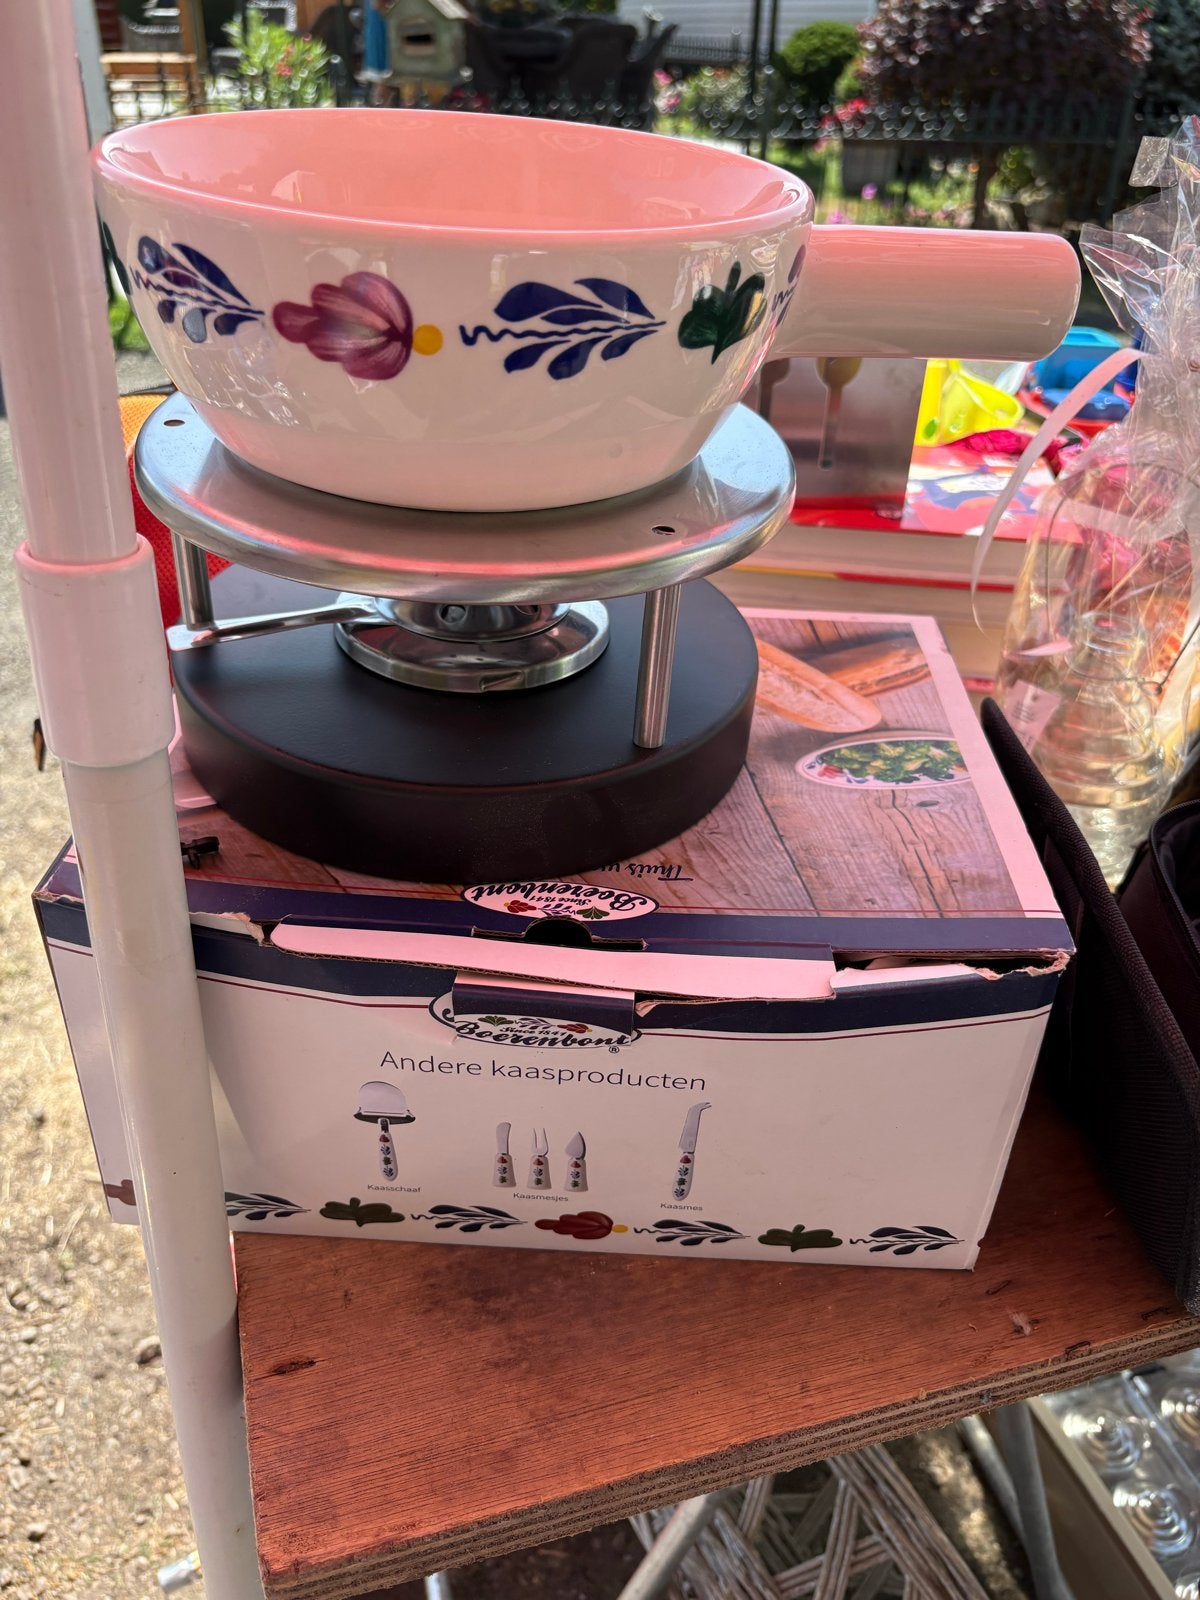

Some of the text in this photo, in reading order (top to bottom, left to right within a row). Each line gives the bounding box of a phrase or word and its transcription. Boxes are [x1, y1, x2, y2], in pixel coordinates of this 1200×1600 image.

[625, 863, 694, 881] Thuis
[471, 882, 648, 912] Boerenbont
[528, 895, 592, 906] Since 1841
[441, 1008, 630, 1047] Boerenbont
[500, 1026, 568, 1037] Since 1841
[380, 1051, 706, 1091] Andere kaasproducten
[367, 1184, 422, 1193] Kaasschaaf
[513, 1192, 569, 1202] Kaasmesjes
[660, 1202, 704, 1211] Kaasmes
